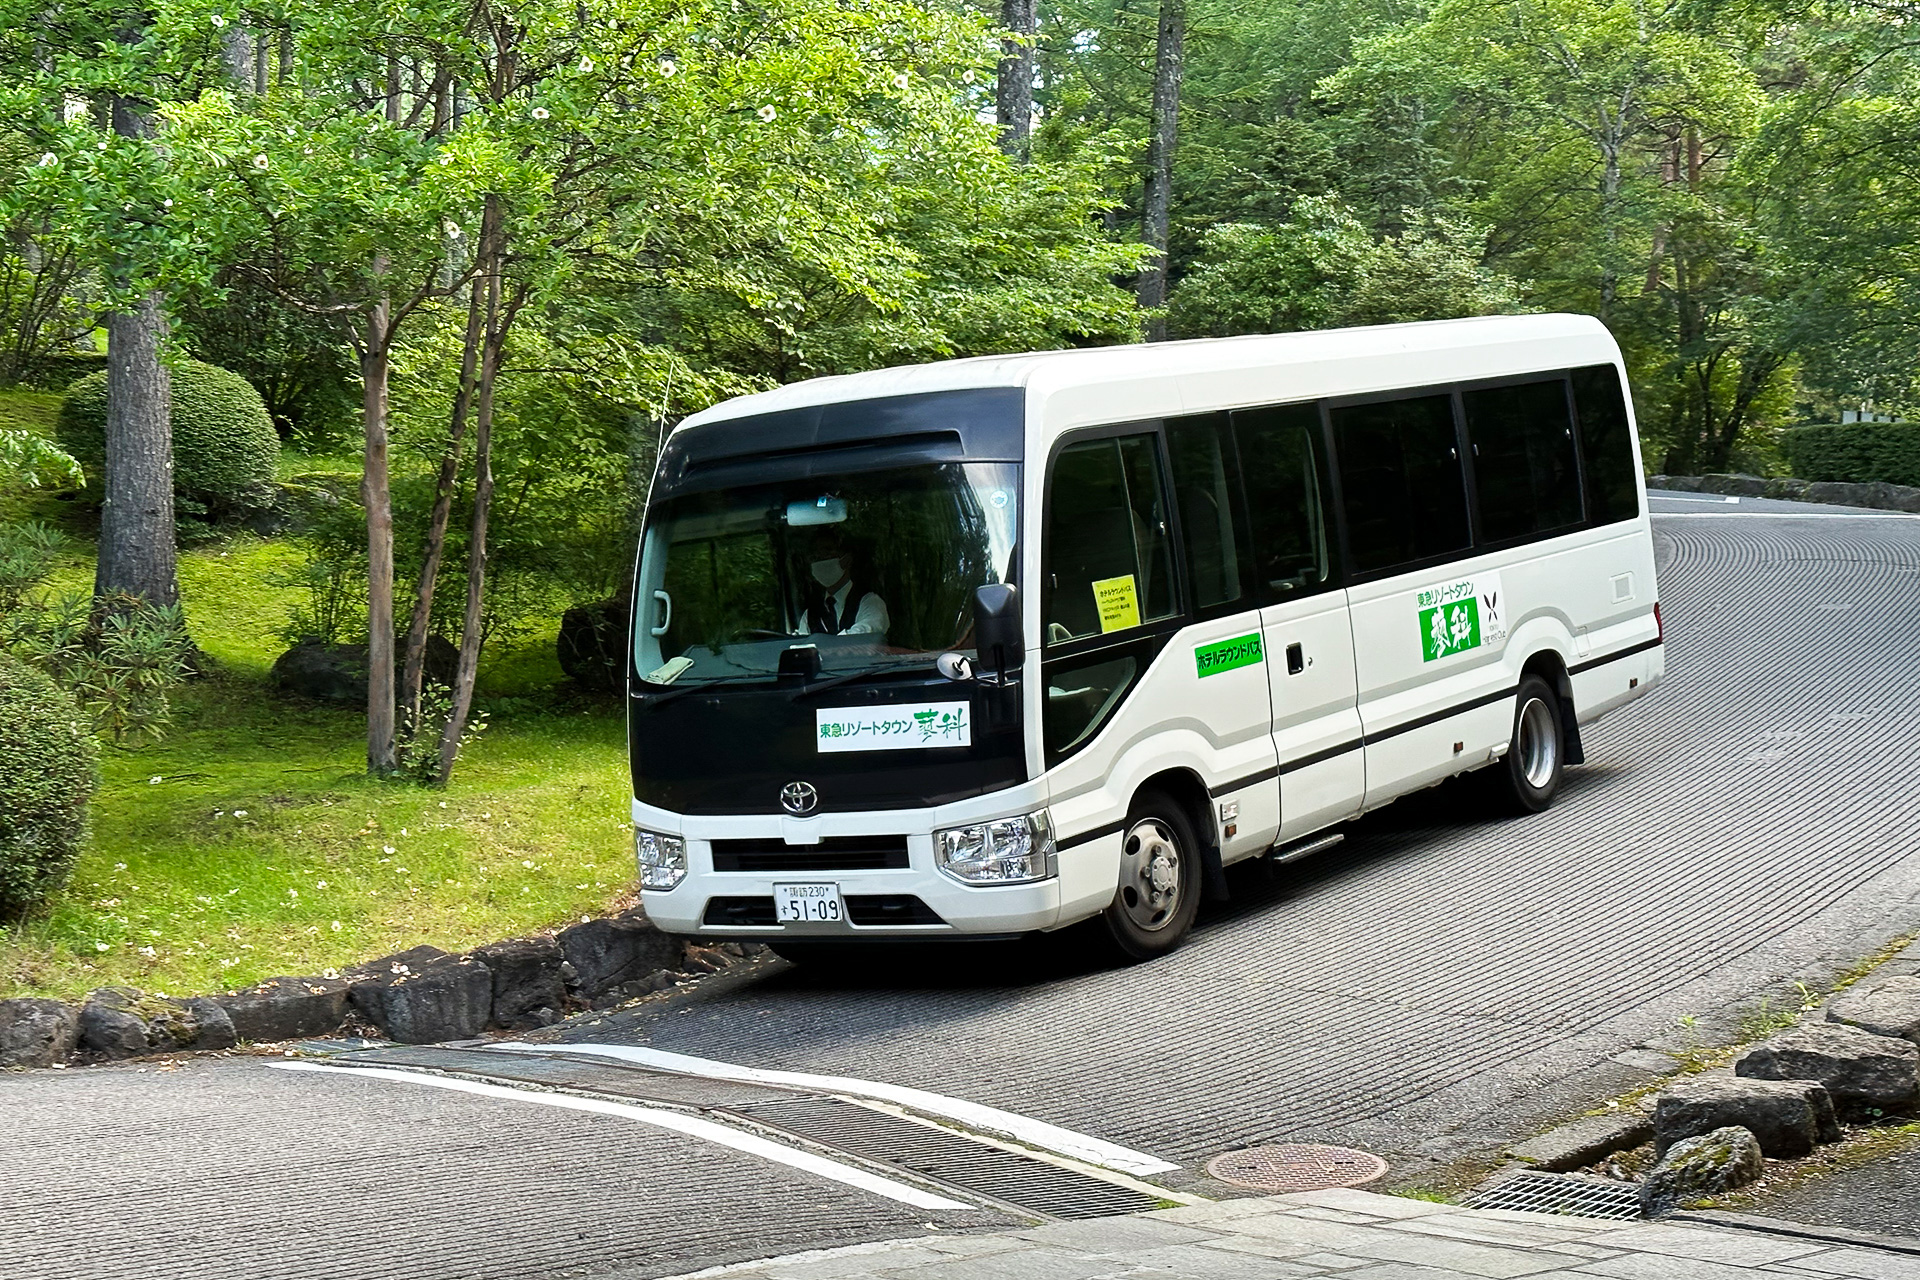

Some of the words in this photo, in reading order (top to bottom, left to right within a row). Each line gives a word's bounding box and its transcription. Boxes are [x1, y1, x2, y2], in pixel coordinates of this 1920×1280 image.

[1417, 581, 1474, 607] 東急リゾートタウン
[1430, 604, 1472, 659] 蓼科
[1198, 641, 1261, 669] ホテルラウンドバス
[820, 720, 913, 738] 東急リゾートタウン
[914, 708, 967, 743] 蓼科
[808, 886, 825, 897] 230
[790, 900, 839, 920] 51-09
